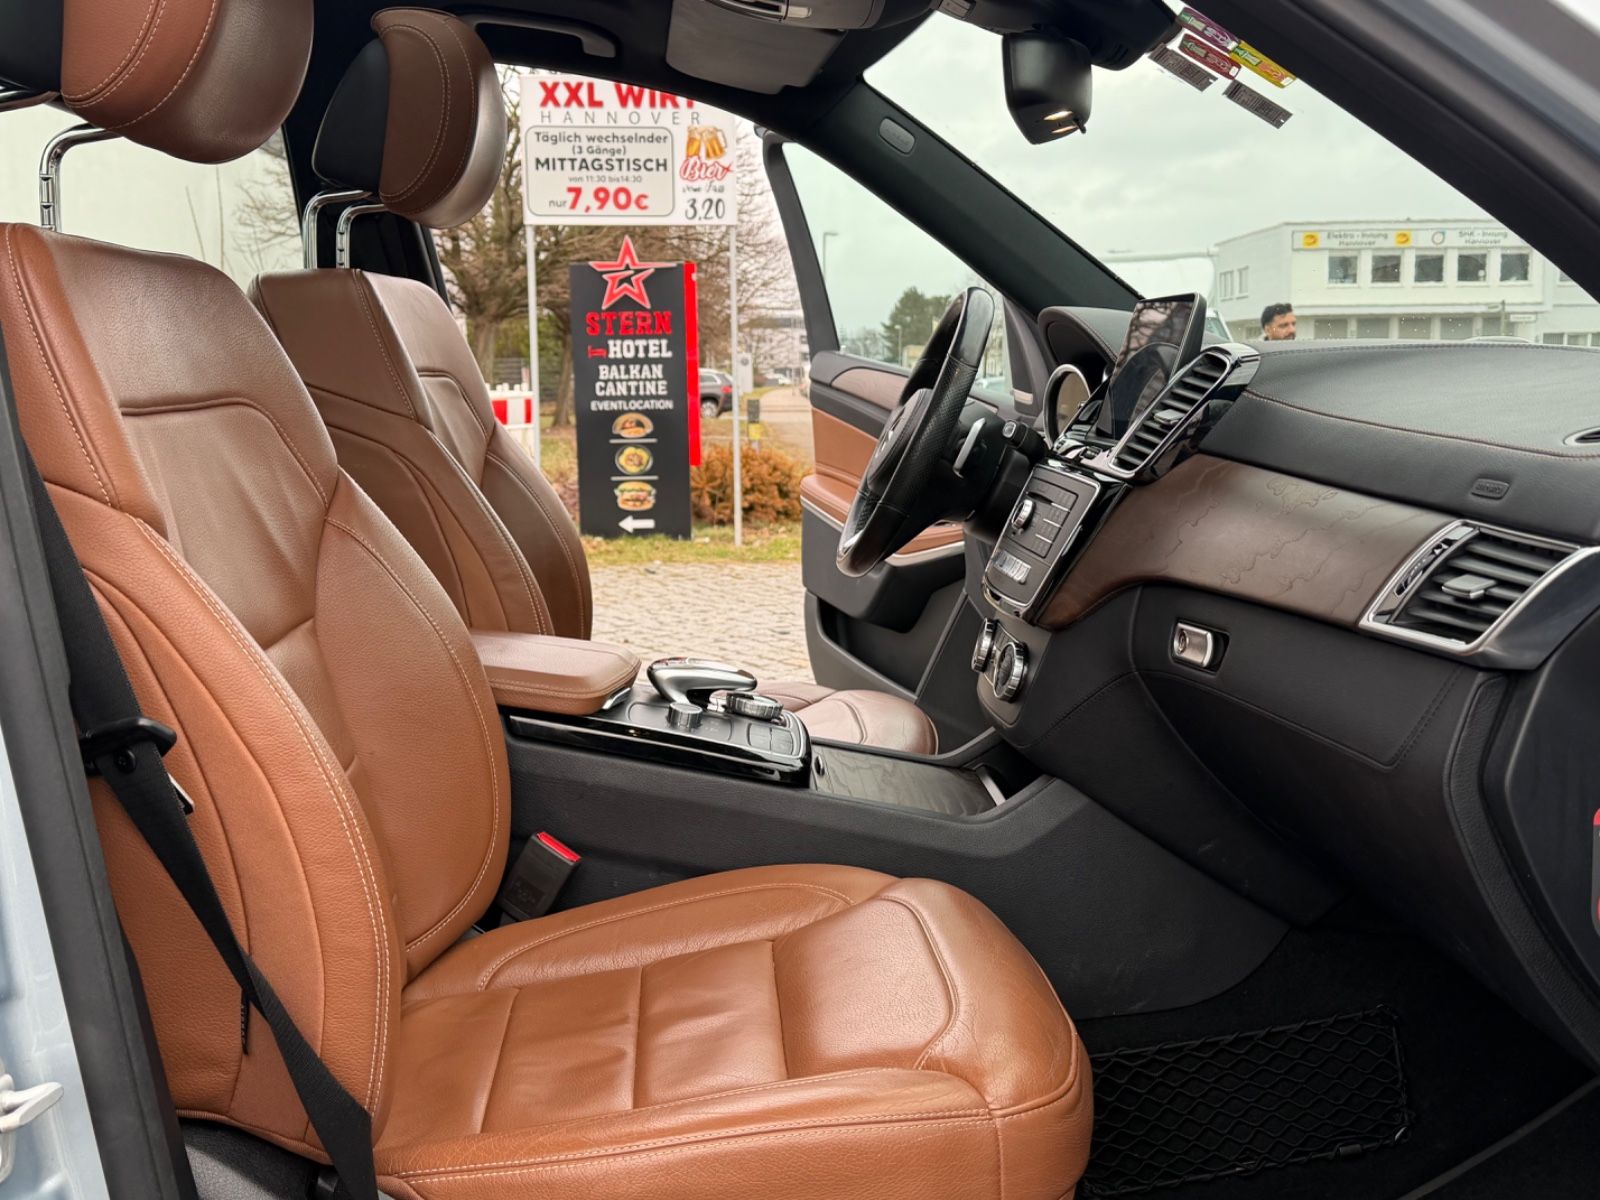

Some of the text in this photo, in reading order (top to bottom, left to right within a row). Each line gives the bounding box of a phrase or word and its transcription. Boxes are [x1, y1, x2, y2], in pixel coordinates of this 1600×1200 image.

[539, 81, 604, 108] XXL
[541, 111, 701, 125] HANNOVER
[535, 131, 668, 145] Täglich wechselnder
[572, 145, 627, 156] (3 Gänge)
[535, 158, 668, 172] MITTAGSTISCH
[680, 157, 733, 182] Bier
[549, 199, 567, 208] nur
[585, 311, 672, 336] STERN
[607, 339, 673, 359] HOTEL
[598, 364, 663, 380] BALKAN
[595, 380, 668, 396] CANTINE
[590, 399, 674, 411] EVENTLOCATION
